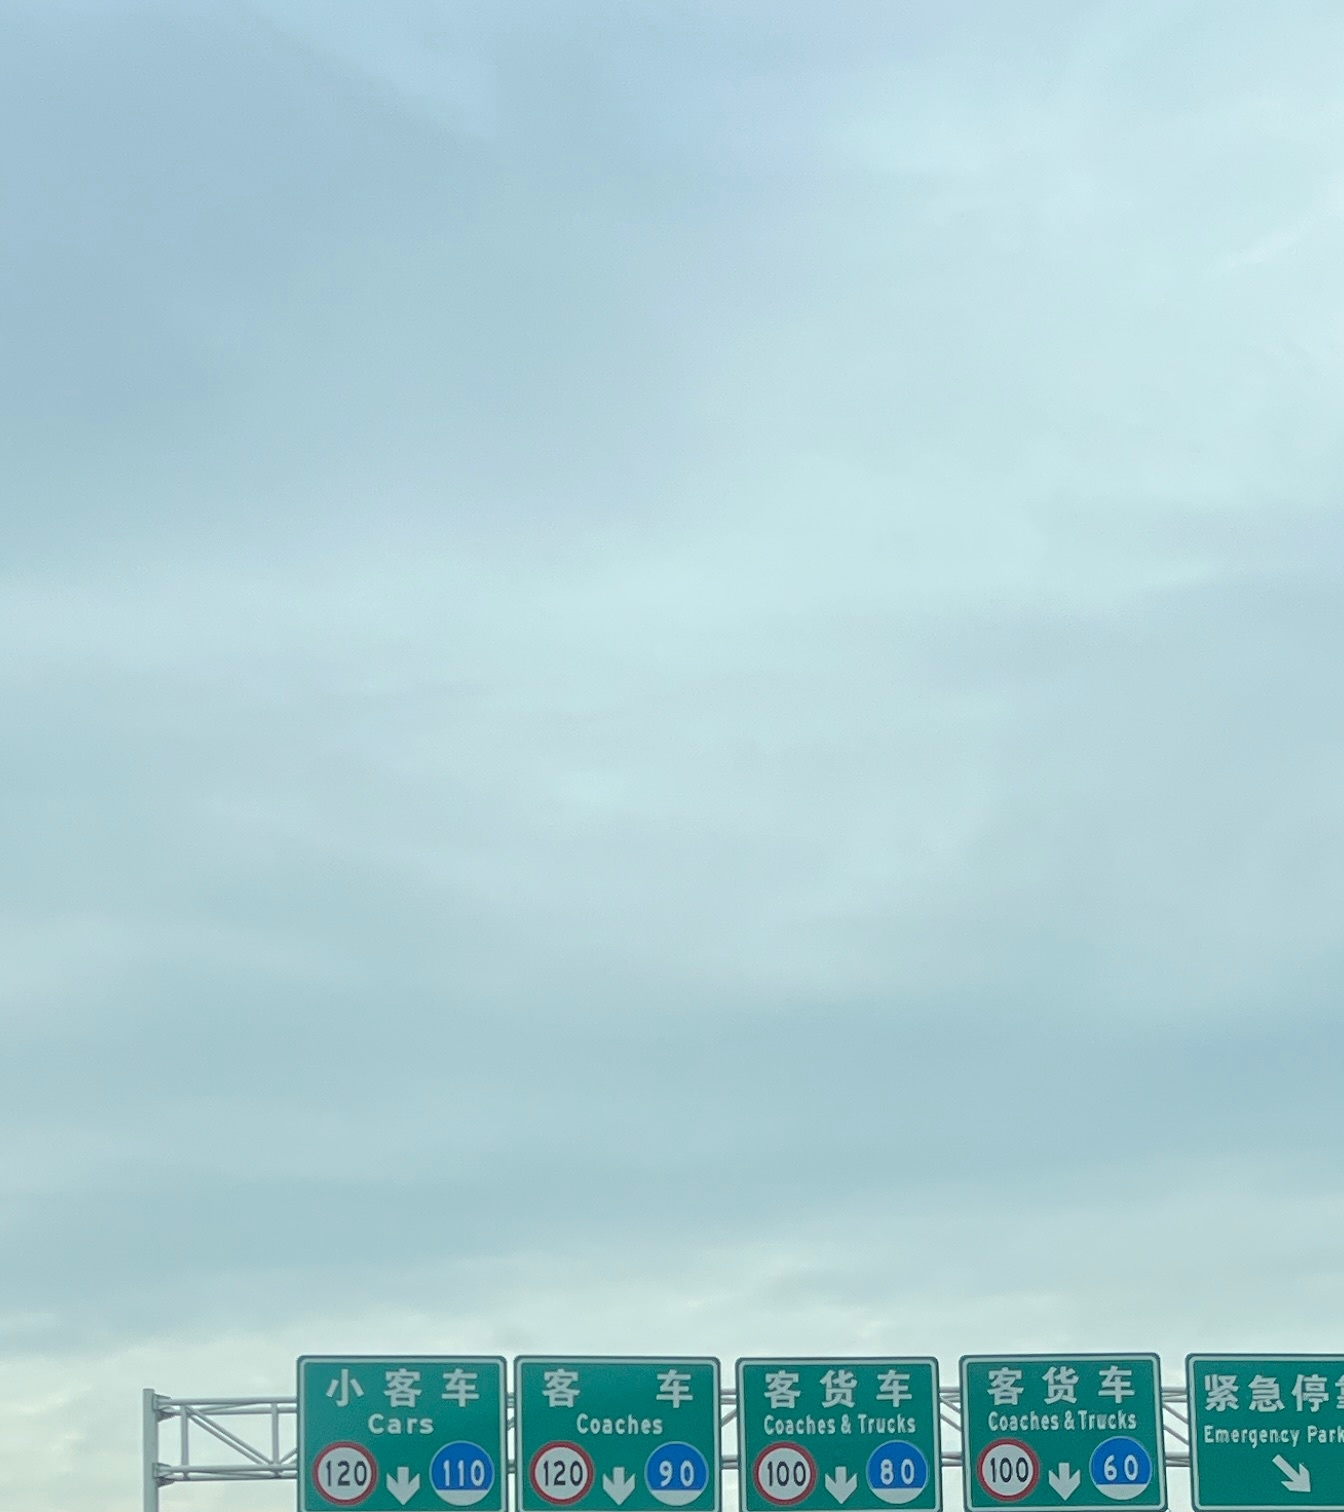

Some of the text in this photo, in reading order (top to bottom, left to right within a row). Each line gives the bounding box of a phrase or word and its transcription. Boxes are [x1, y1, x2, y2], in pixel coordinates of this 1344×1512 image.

[327, 1369, 479, 1408] 小客车
[764, 1370, 912, 1409] 客货车
[988, 1366, 1135, 1406] 客货车
[369, 1414, 434, 1434] Cars
[577, 1414, 663, 1435] Coaches
[764, 1415, 916, 1435] Coaches & Trucks
[988, 1410, 1136, 1431] Coaches & Trucks
[1204, 1425, 1300, 1449] Emergency
[325, 1460, 368, 1487] 120
[443, 1460, 485, 1486] 110
[543, 1460, 584, 1487] 120
[660, 1460, 694, 1486] 90
[767, 1460, 806, 1487] 100
[880, 1459, 915, 1484] 80
[990, 1456, 1029, 1483] 100
[1104, 1456, 1138, 1482] 60
